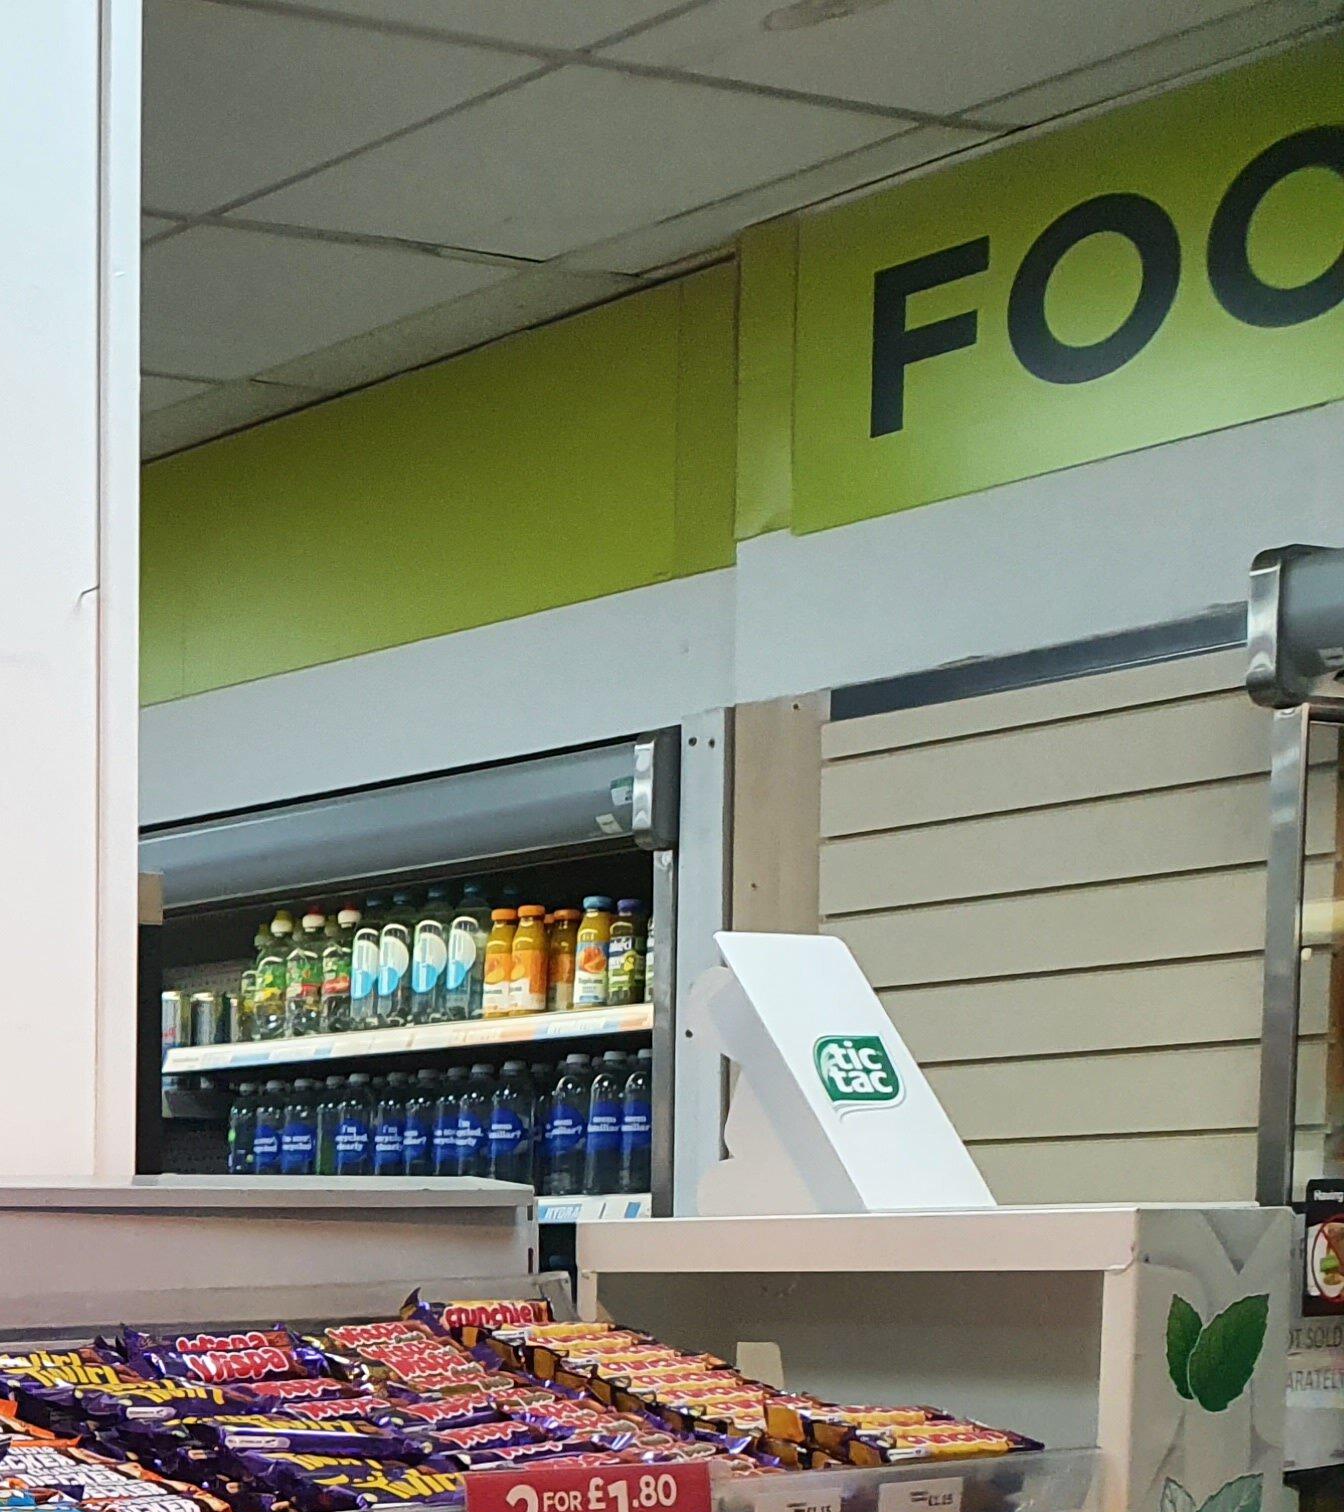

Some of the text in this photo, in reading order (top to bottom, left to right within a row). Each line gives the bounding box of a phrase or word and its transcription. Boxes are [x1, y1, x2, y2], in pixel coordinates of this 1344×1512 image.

[834, 1040, 883, 1071] tic
[830, 1065, 893, 1095] tac
[543, 1491, 582, 1512] FOR
